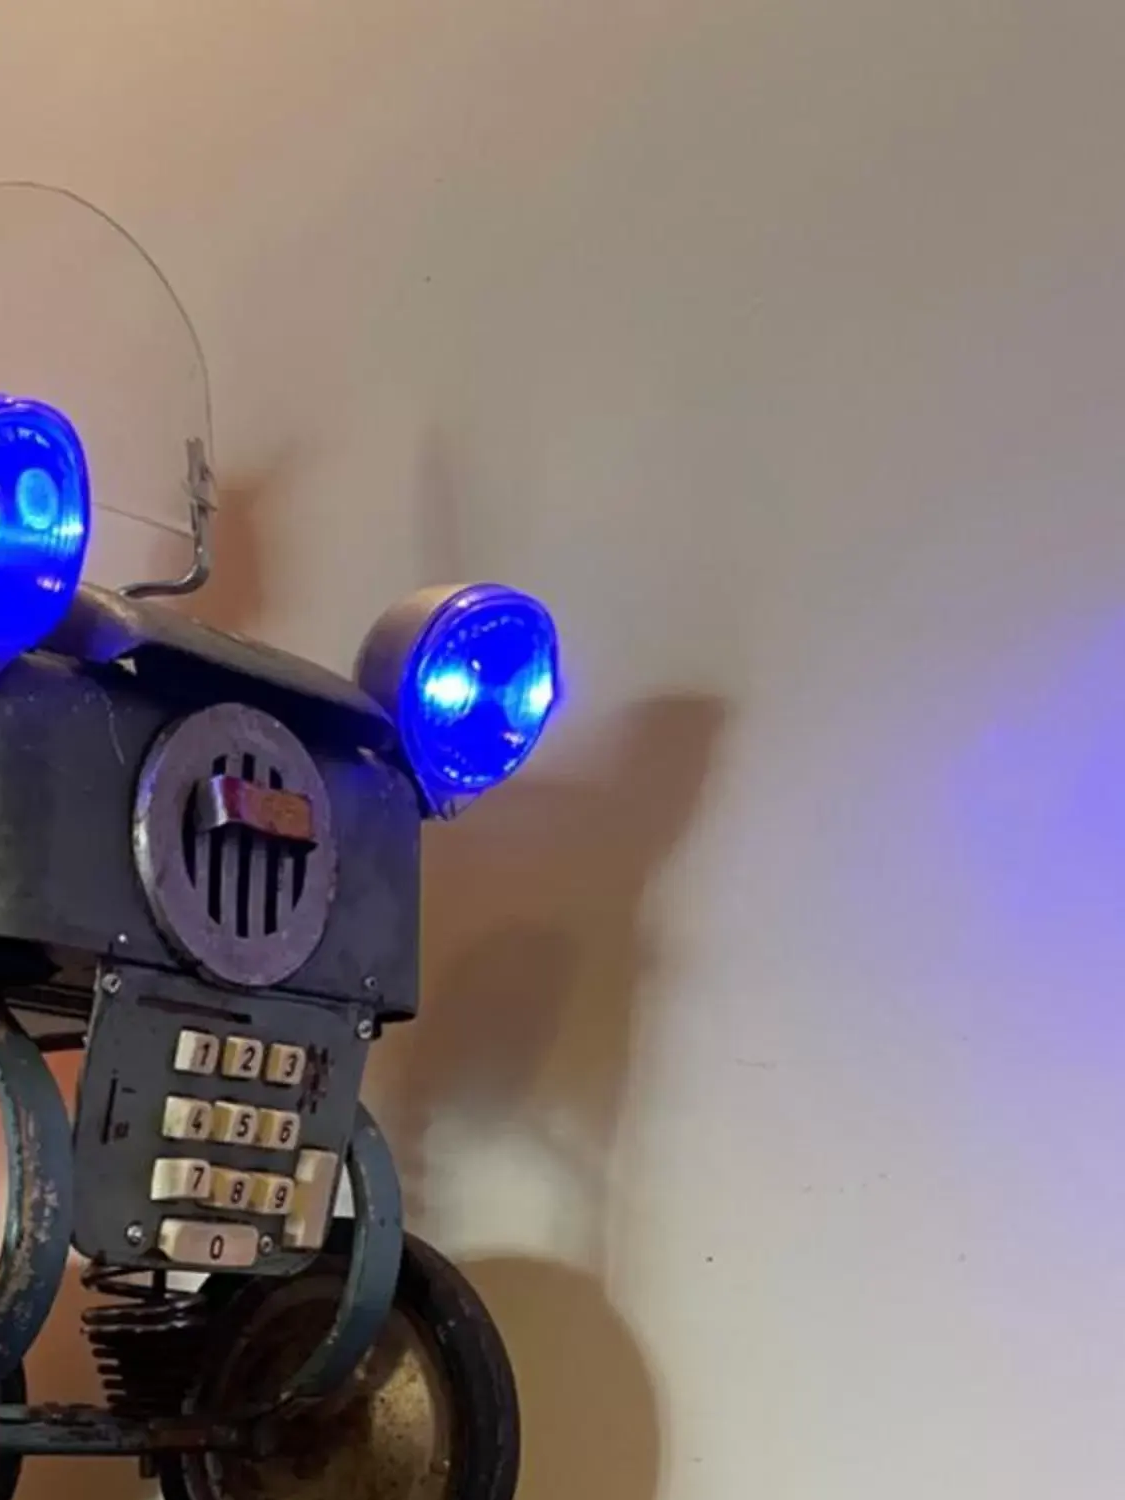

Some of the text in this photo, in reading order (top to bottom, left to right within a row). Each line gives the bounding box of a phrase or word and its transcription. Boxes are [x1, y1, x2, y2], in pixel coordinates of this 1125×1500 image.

[200, 1043, 297, 1077] 1 2 3
[192, 1107, 290, 1144] 4 5 6
[192, 1167, 287, 1208] 7 8 9
[210, 1235, 224, 1259] 0
